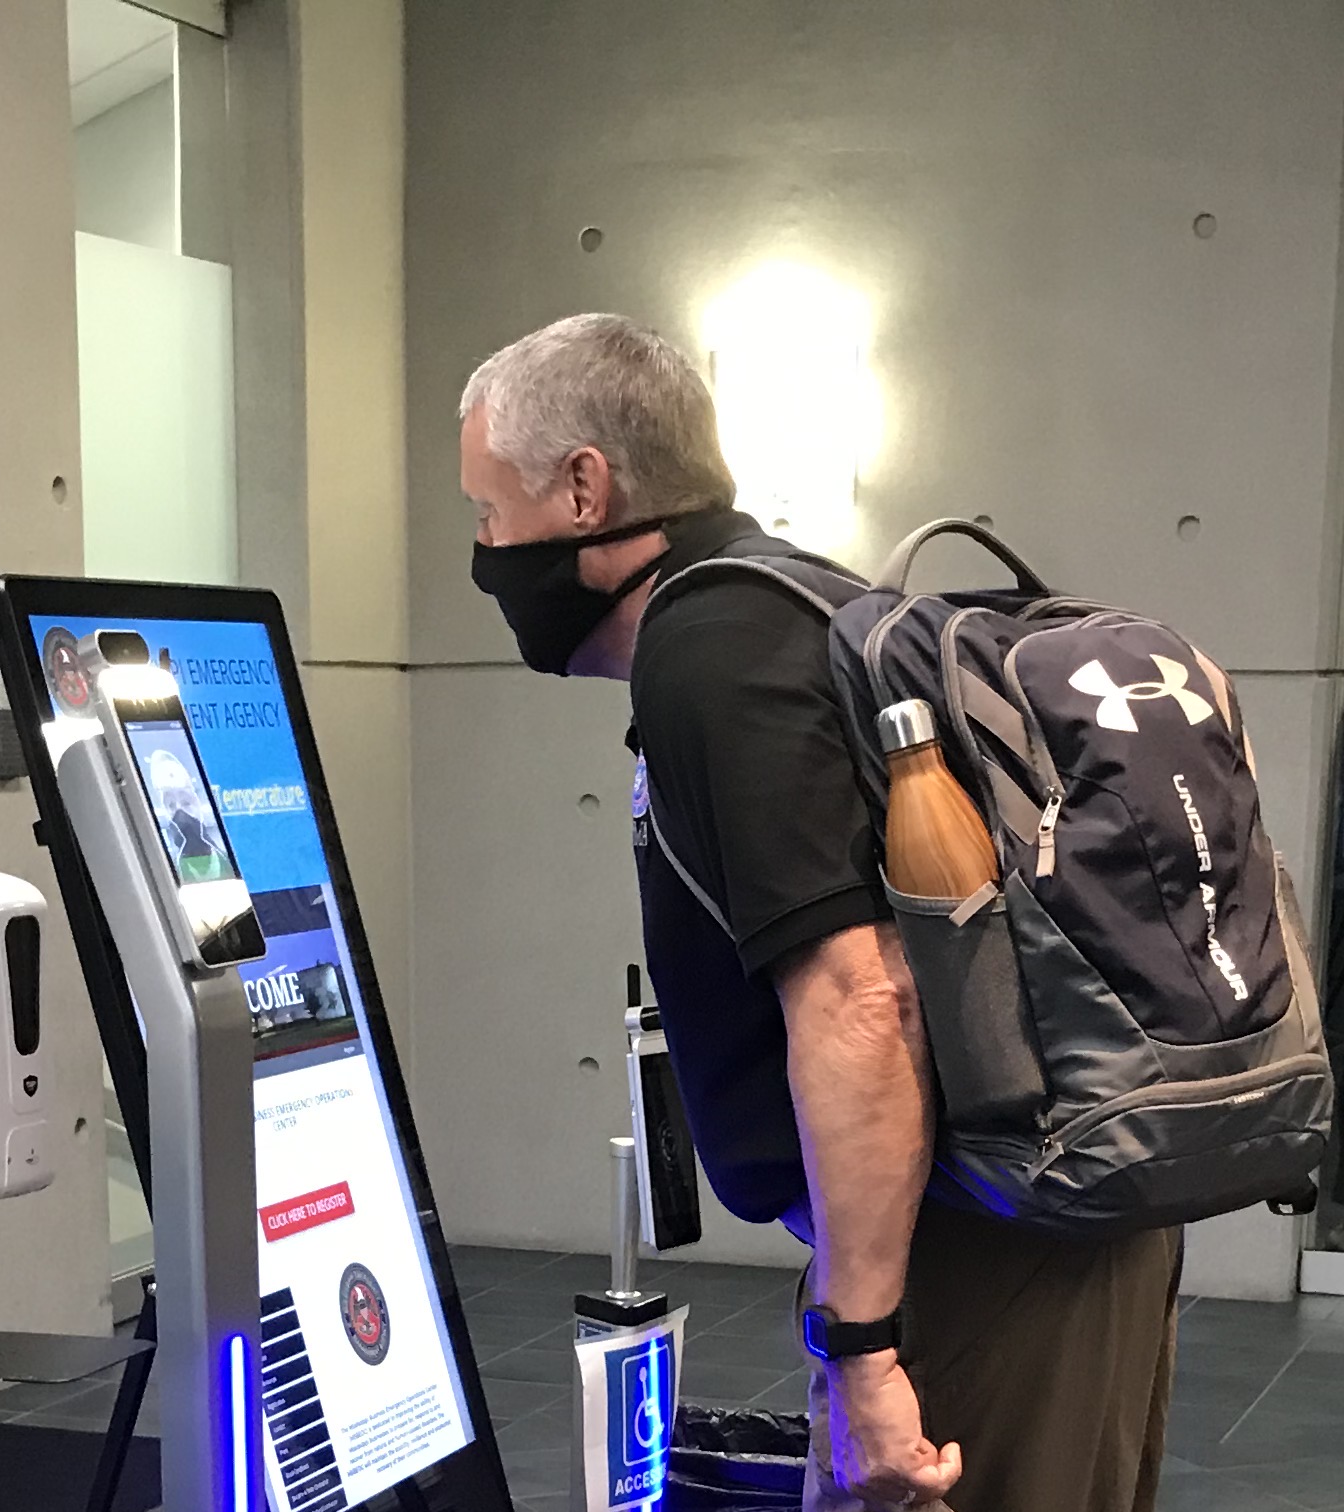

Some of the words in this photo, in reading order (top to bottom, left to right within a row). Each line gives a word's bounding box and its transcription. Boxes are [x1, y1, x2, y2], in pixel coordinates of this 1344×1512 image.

[186, 658, 277, 686] EMERGENCY
[223, 701, 282, 729] AGENCY
[210, 783, 307, 816] Temperature
[1172, 773, 1213, 874] UNDER
[1199, 881, 1250, 1002] ARMOUR
[267, 1212, 289, 1230] CLICK
[287, 1205, 307, 1224] HERE
